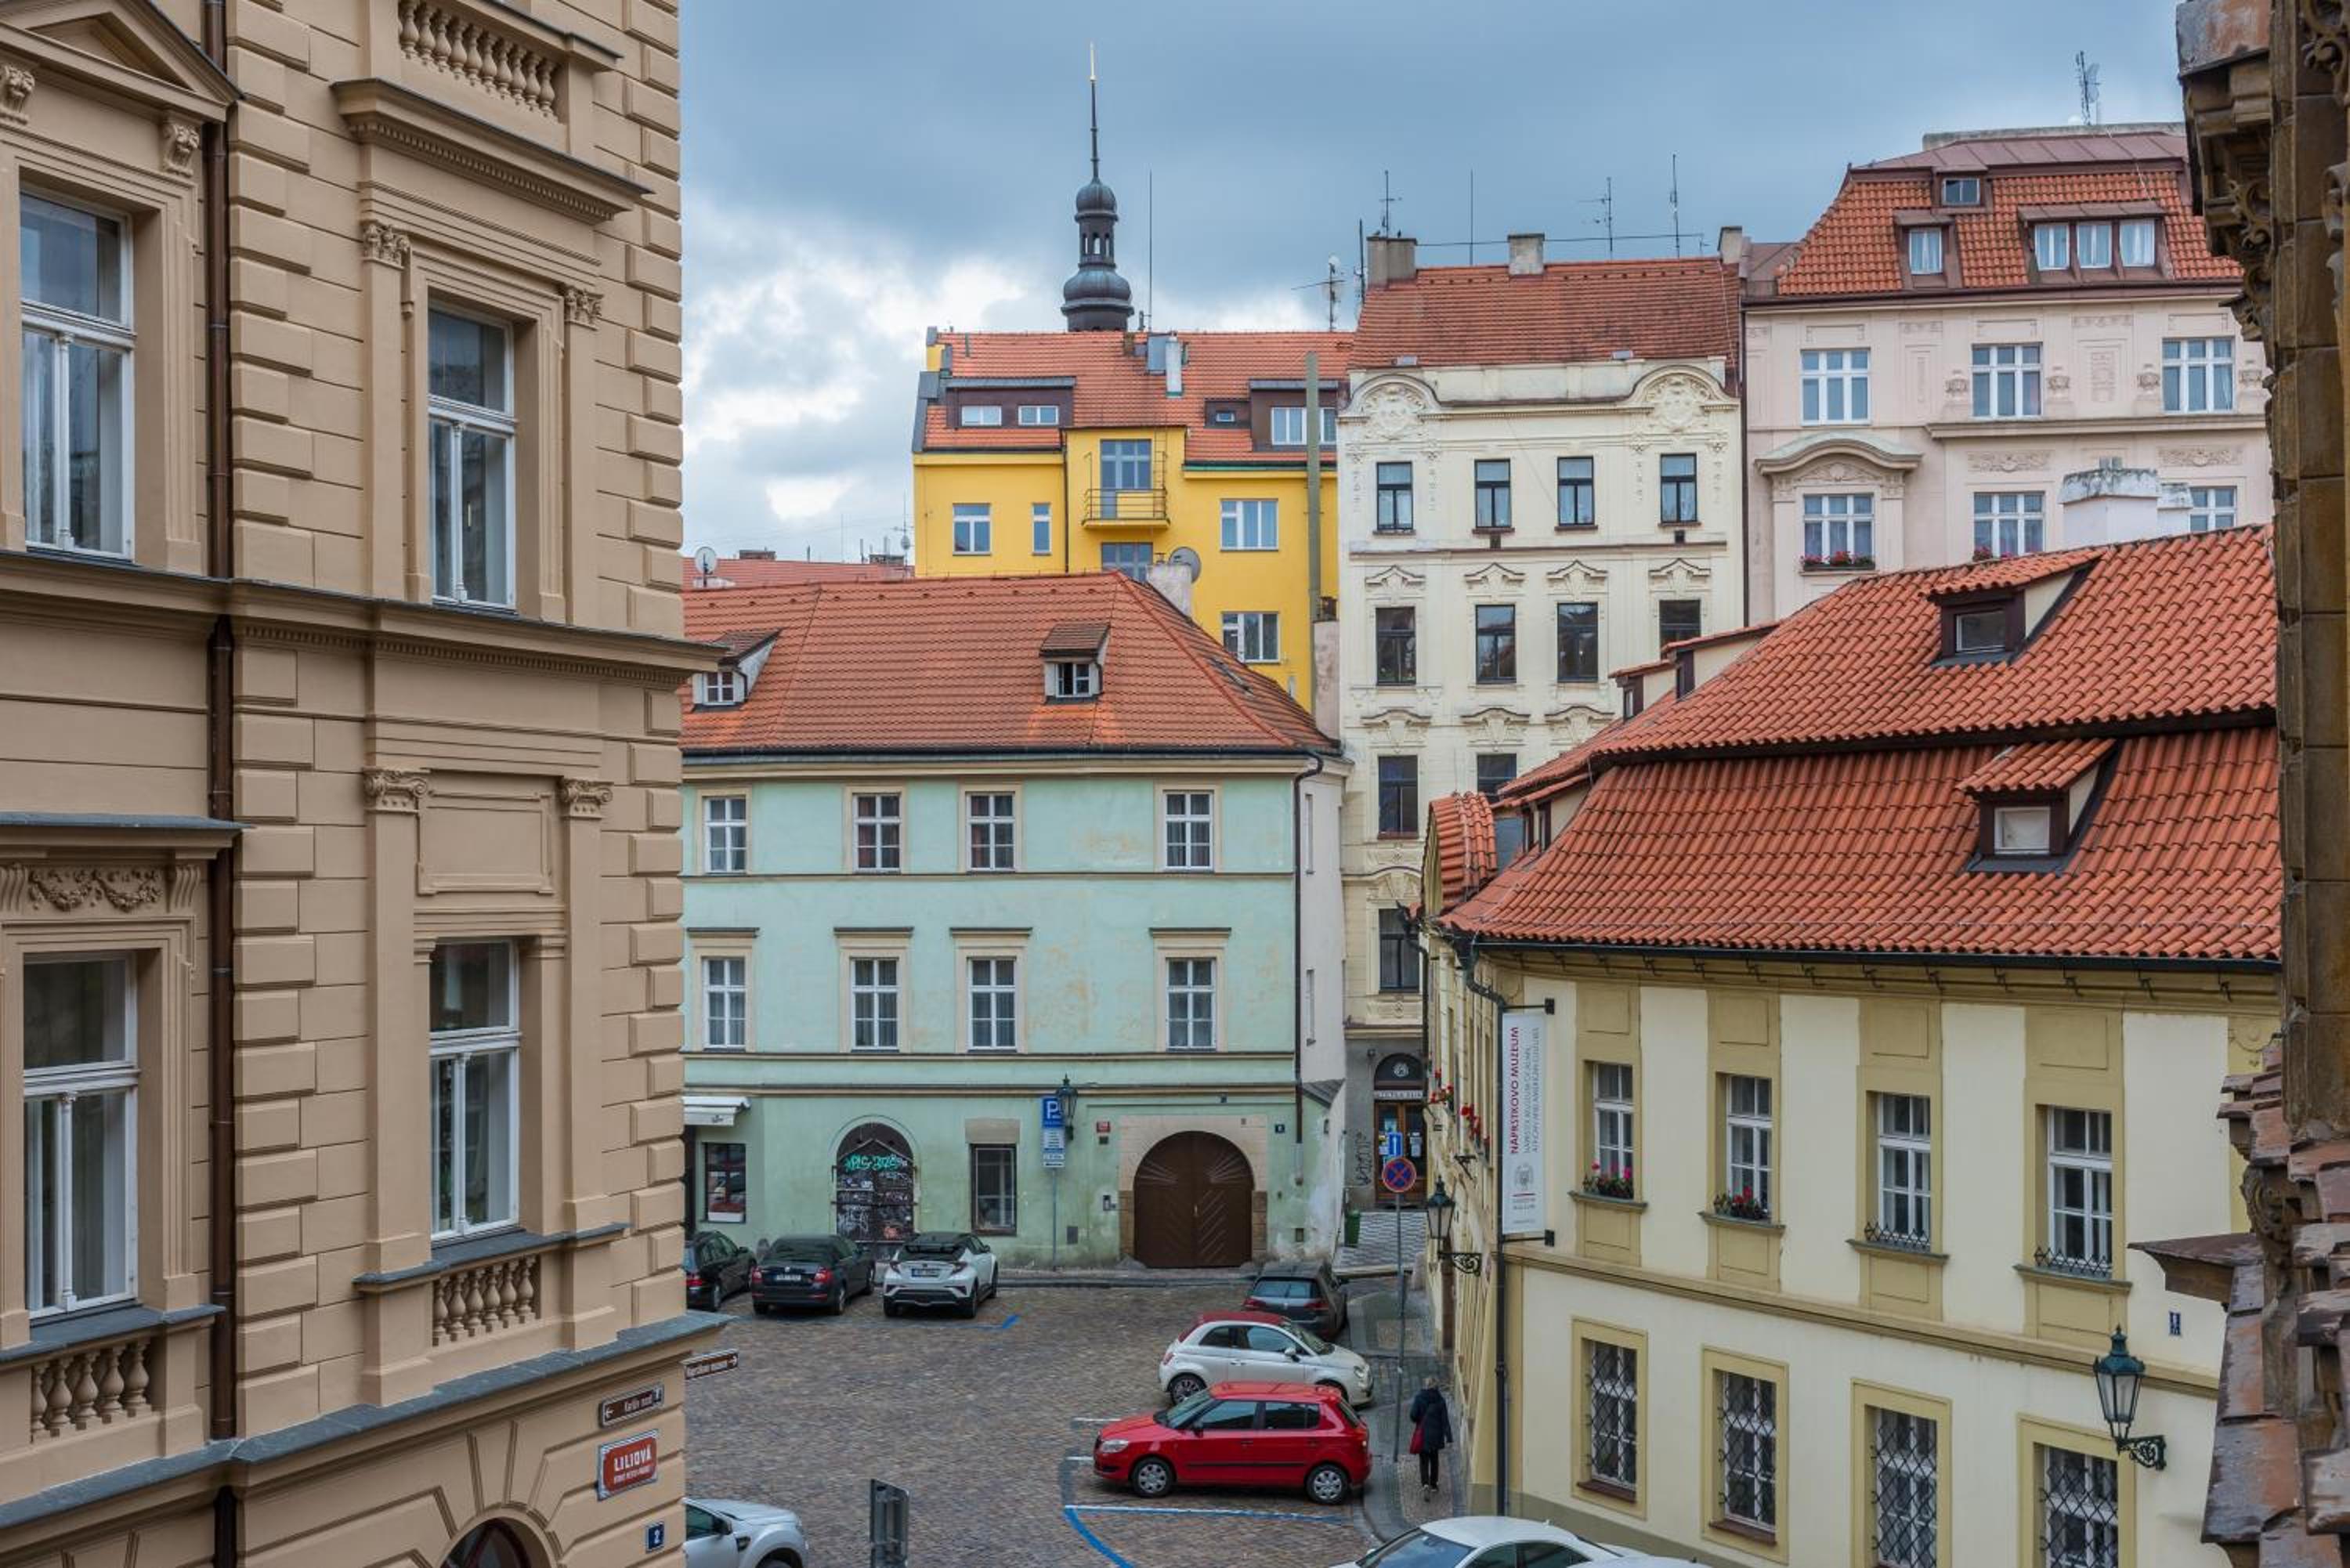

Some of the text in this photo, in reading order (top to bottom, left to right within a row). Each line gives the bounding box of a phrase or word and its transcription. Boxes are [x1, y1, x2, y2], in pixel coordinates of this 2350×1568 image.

[1509, 1027, 1519, 1077] MUZEUM
[1046, 1100, 1058, 1119] P
[614, 1445, 651, 1471] LILIOVÁ
